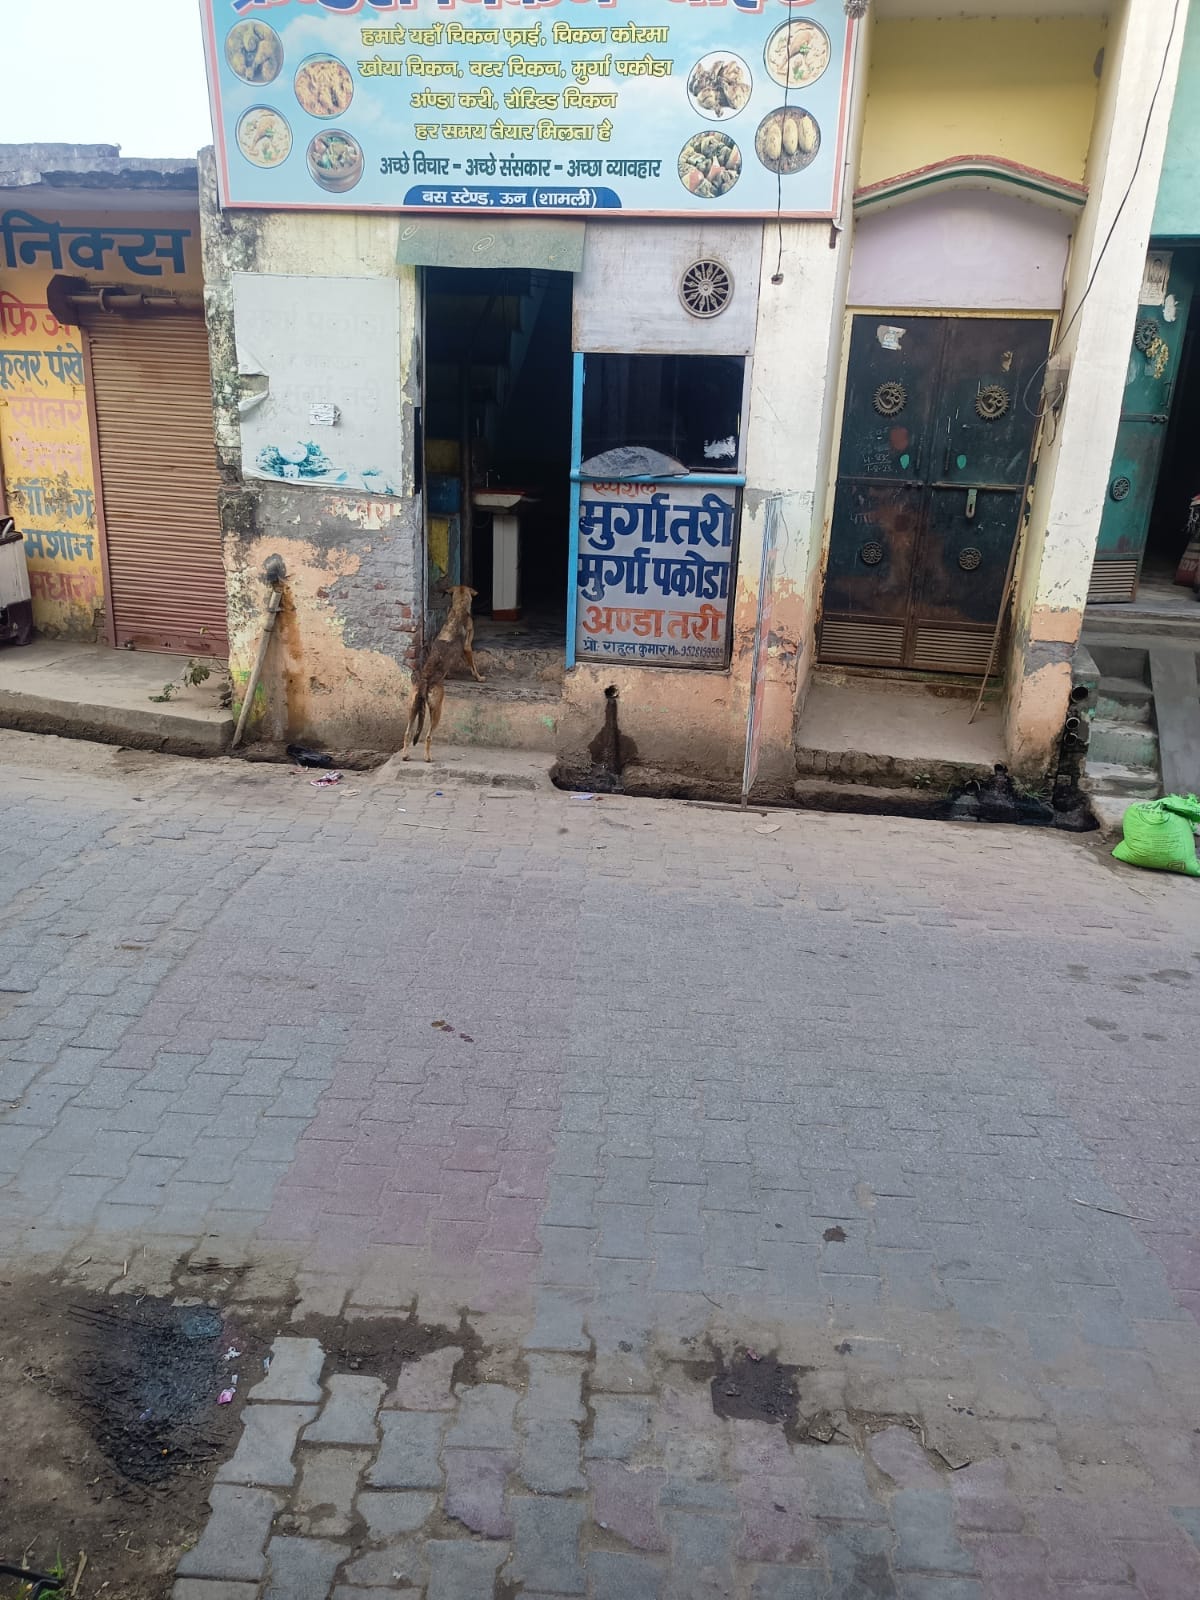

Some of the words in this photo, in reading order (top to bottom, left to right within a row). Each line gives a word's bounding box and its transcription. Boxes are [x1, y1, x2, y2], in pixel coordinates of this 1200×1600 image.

[361, 24, 406, 46] हमारे
[409, 22, 445, 45] यहाँ
[447, 23, 500, 45] चिकन
[503, 23, 547, 47] फ्राई,
[553, 23, 606, 44] चिकन
[611, 23, 669, 44] कोरमा
[357, 56, 402, 77] खोया
[406, 55, 464, 78] चिकन,
[469, 60, 504, 77] बटर
[508, 55, 567, 78] चिकन,
[572, 54, 612, 84] मुर्गा
[615, 54, 674, 77] पकौडा
[458, 88, 499, 110] करी,
[504, 87, 559, 109] रोस्टिड
[563, 87, 618, 109] चिकन
[415, 122, 439, 140] हर
[442, 123, 487, 140] समय
[491, 118, 534, 140] तैयार
[537, 119, 594, 141] मिलता
[597, 118, 613, 141] है
[380, 150, 409, 175] अच्छे
[413, 150, 450, 176] विचार
[465, 152, 496, 176] अच्छे
[499, 153, 551, 177] संसकार
[566, 158, 602, 177] अच्छा
[606, 158, 662, 178] व्यावहार
[422, 190, 447, 204] बस
[499, 190, 526, 205] ऊन
[532, 187, 597, 208] (शामली)
[578, 493, 670, 550] मुर्गा
[669, 493, 736, 548] तरी
[578, 547, 651, 602] मुर्गा
[582, 606, 665, 638] अण्डा
[667, 604, 726, 642] तरी
[602, 640, 638, 656] राहुल
[638, 643, 668, 658] कुमार
